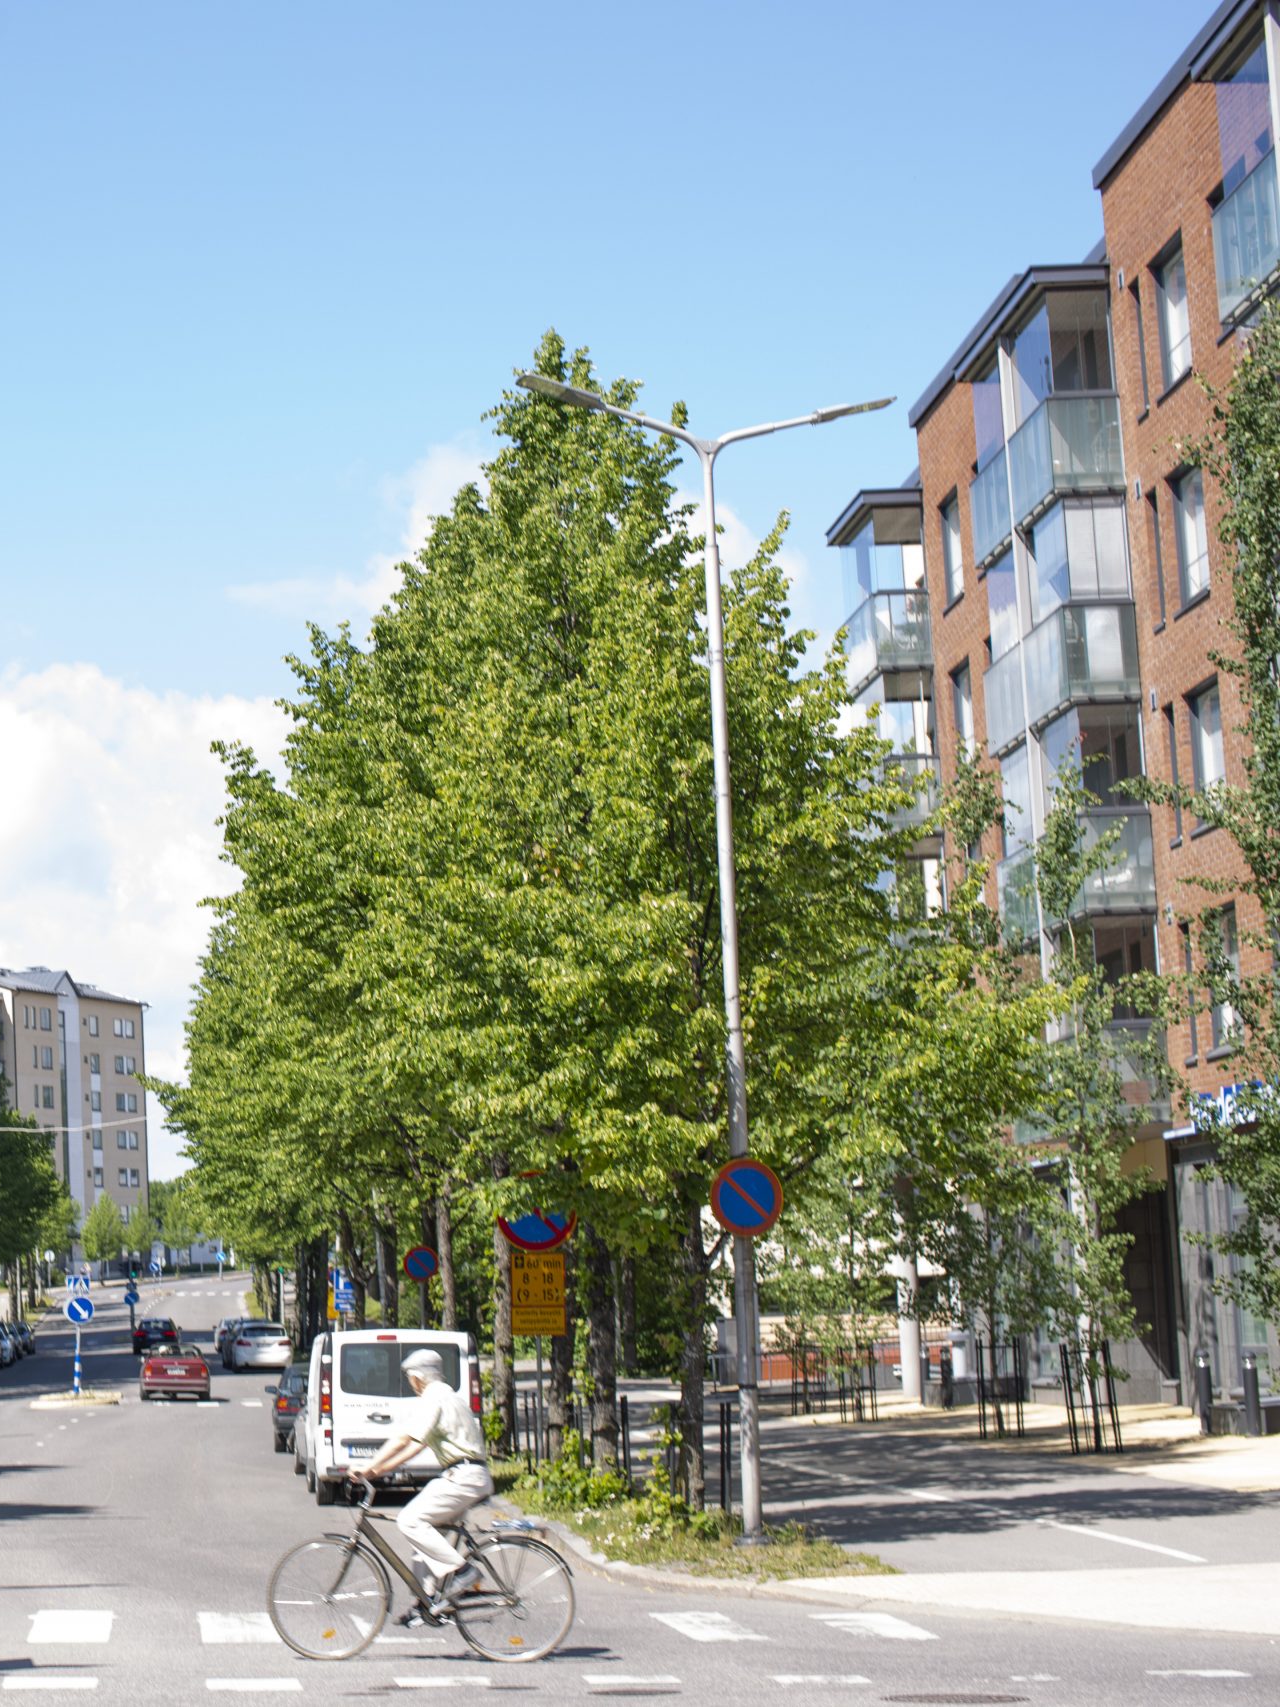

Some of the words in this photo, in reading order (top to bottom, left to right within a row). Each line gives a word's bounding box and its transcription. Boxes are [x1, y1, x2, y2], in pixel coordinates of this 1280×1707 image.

[527, 1258, 540, 1269] 60
[543, 1259, 561, 1269] min
[522, 1272, 530, 1285] 8
[542, 1272, 554, 1285] 18
[517, 1288, 530, 1303] (9
[542, 1288, 560, 1303] 15)
